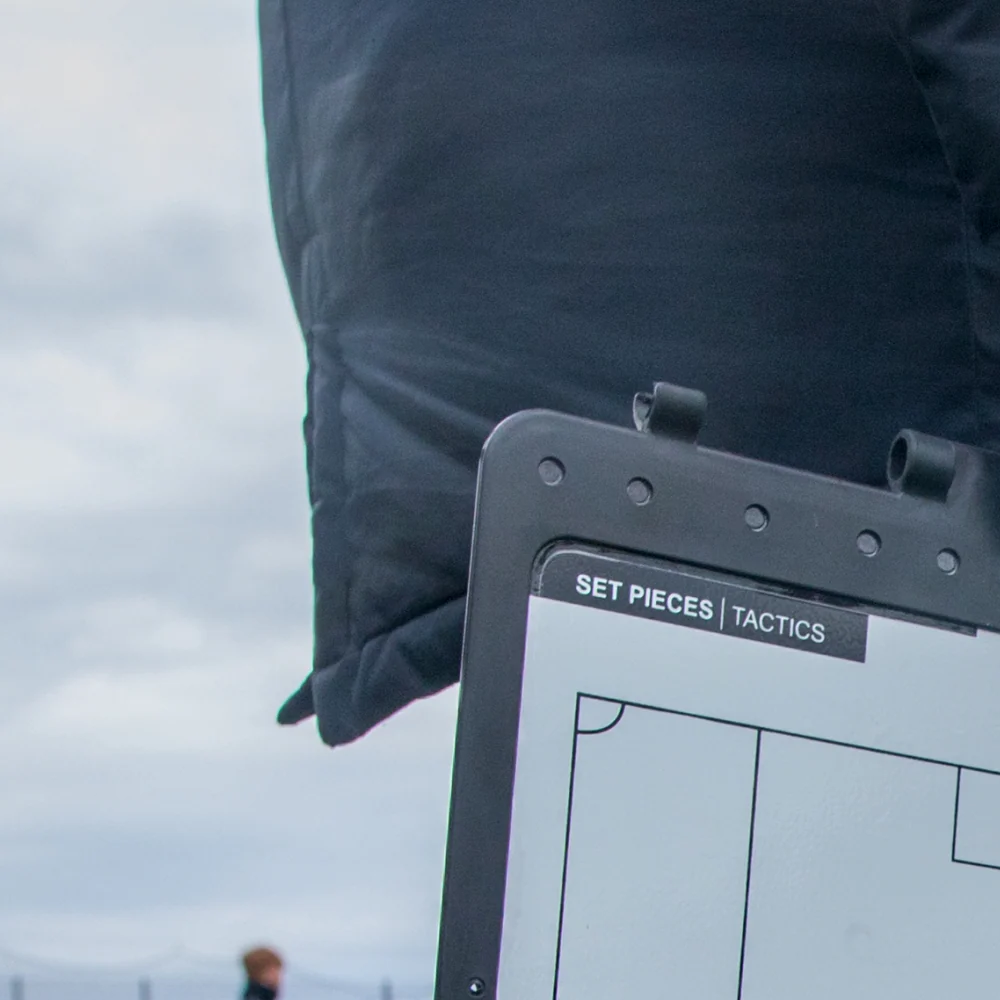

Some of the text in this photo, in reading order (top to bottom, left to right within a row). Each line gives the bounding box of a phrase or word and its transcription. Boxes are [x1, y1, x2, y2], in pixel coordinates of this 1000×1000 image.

[575, 573, 826, 644] SET PIECES TACTICS
